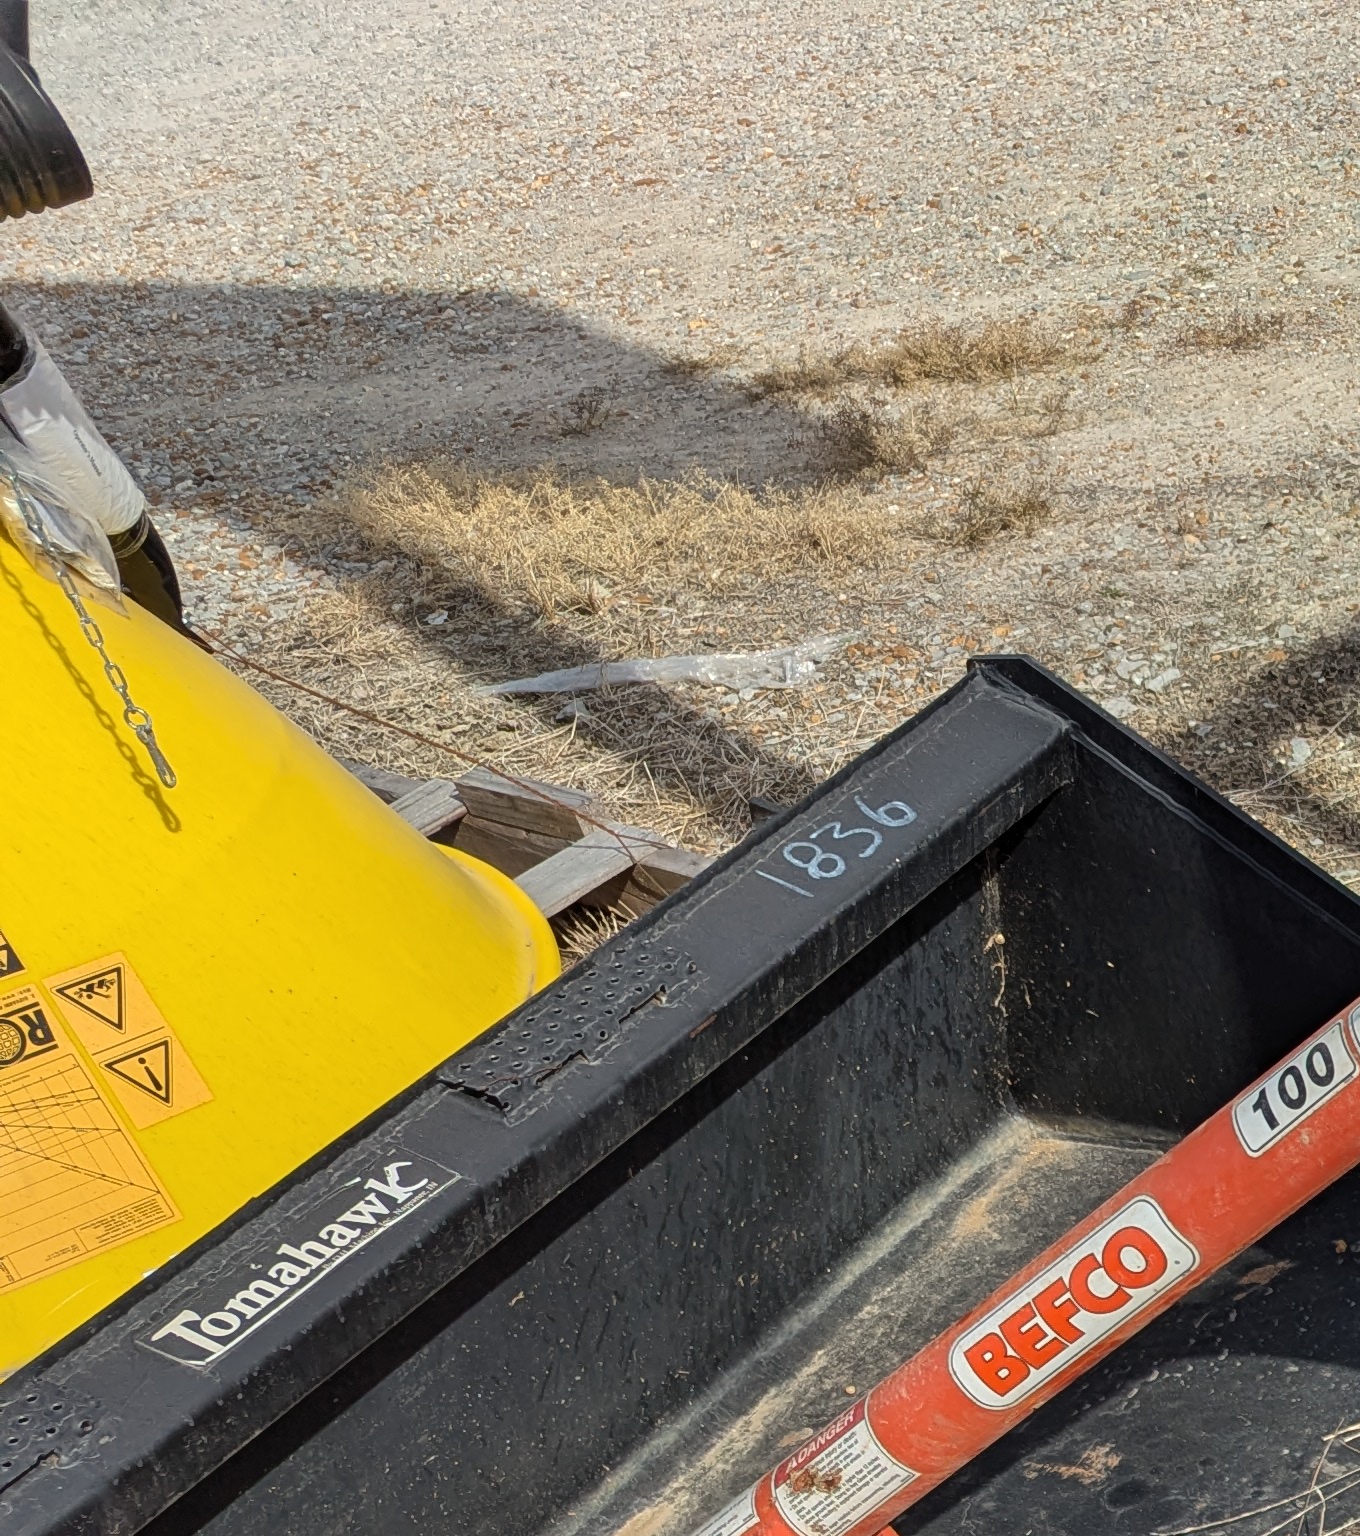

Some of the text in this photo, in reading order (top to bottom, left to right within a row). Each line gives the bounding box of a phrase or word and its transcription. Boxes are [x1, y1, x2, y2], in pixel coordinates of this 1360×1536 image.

[755, 795, 918, 897] 1836
[1251, 1042, 1336, 1132] 100
[426, 1181, 438, 1191] IN
[151, 1161, 429, 1359] Tomahawk
[964, 1227, 1168, 1397] BEFCO
[797, 1407, 854, 1463] DANGER
